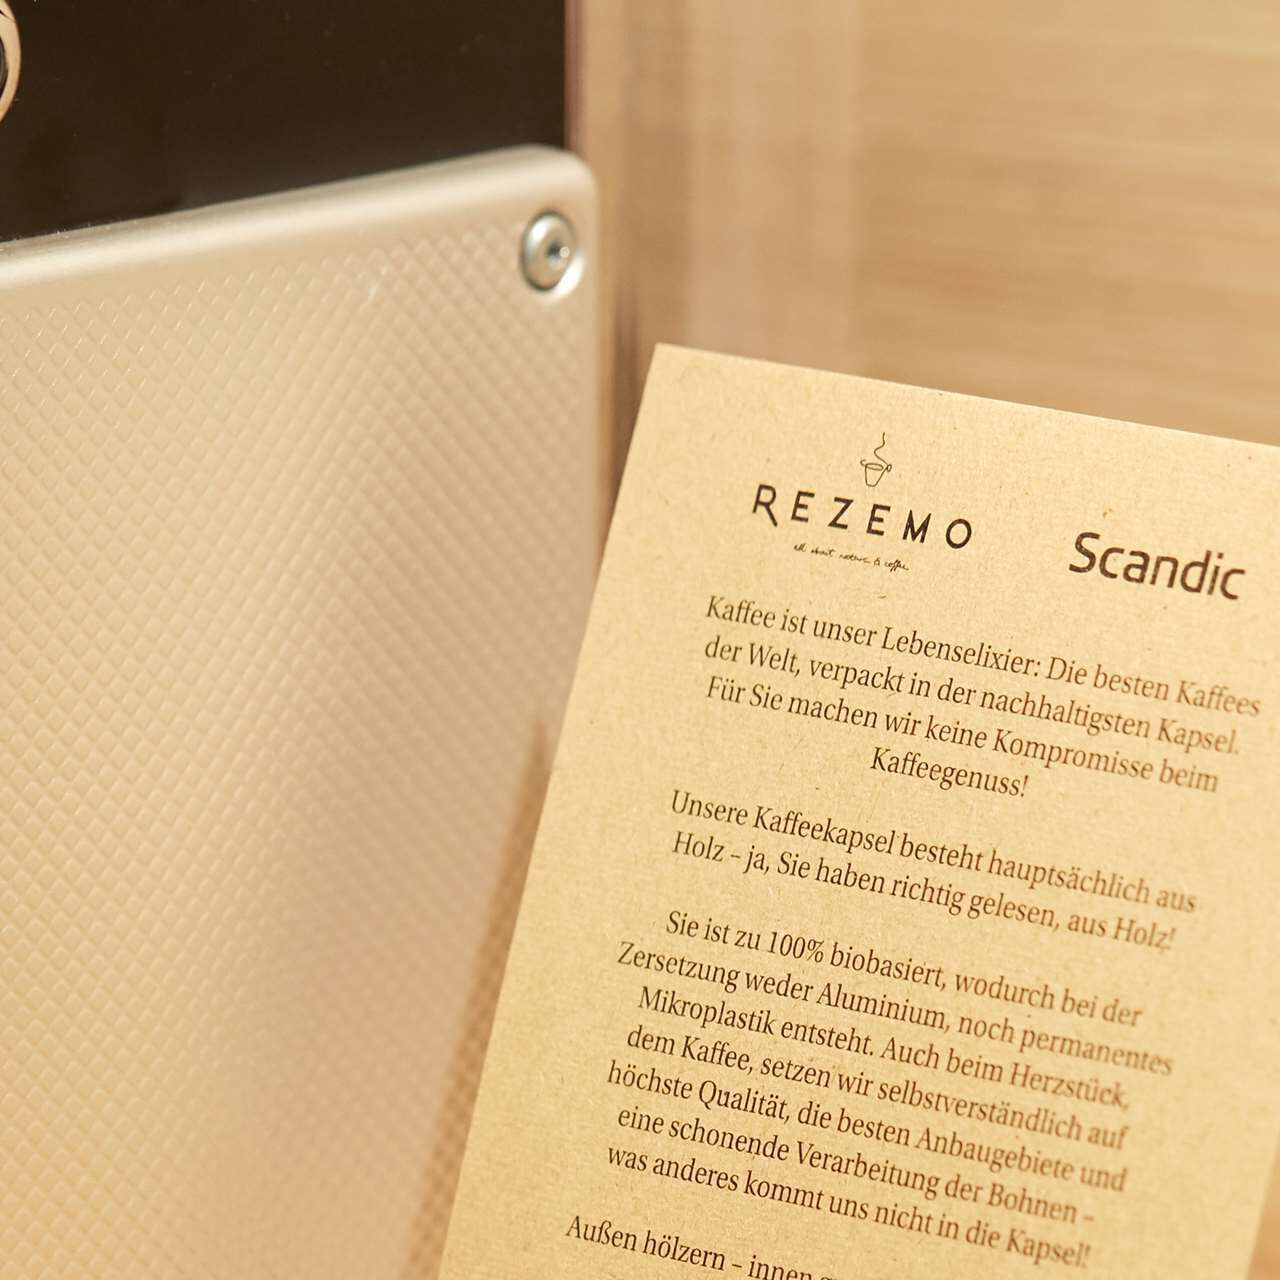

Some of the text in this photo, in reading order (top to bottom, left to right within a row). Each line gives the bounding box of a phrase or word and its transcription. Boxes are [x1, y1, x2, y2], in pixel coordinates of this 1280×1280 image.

[752, 483, 973, 550] REZEMO
[1068, 531, 1246, 601] Scandic
[704, 634, 1240, 756] der Welt, verpackt in der nachhaltigsten Kapsel.
[706, 595, 1261, 717] Kaffee ist unser Lebenselixier: Die besten Kaffees
[706, 675, 1219, 793] Für Sie machen wir keine Kompromisse beim
[870, 746, 1029, 798] Kaffeegenuss!
[671, 789, 1197, 913] Unsere Kaffeekapsel besteht hauptsächlich aus
[672, 831, 725, 862] Holz
[742, 845, 770, 875] ja,
[777, 851, 811, 879] Sie
[814, 856, 885, 894] haben
[889, 875, 966, 916] richtig
[967, 892, 1060, 932] gelesen,
[1067, 914, 1107, 937] aus
[1112, 916, 1177, 951] Holz!
[617, 941, 1173, 1076] Zersetzung weder Aluminium, noch permanentes
[666, 910, 1143, 1028] Sie ist zu 100% biobasiert, wodurch bei der
[627, 1024, 1131, 1151] dem Kaffee, setzen wir selbstverständlich auf
[638, 985, 1130, 1111] Mikroplastik entsteht. Auch beim Herzstück,
[607, 1059, 1129, 1193] höchste Qualität, die besten Anbaugebiete und
[617, 1105, 665, 1134] eine
[668, 1117, 790, 1161] schonende
[797, 1140, 941, 1201] Verarbeitung
[944, 1173, 984, 1203] der
[987, 1182, 1078, 1225] Bohnen
[565, 1215, 637, 1252] Außen
[642, 1230, 726, 1271] hölzern
[608, 1147, 1092, 1269] was anderes kommt uns nicht in die Kapsel!
